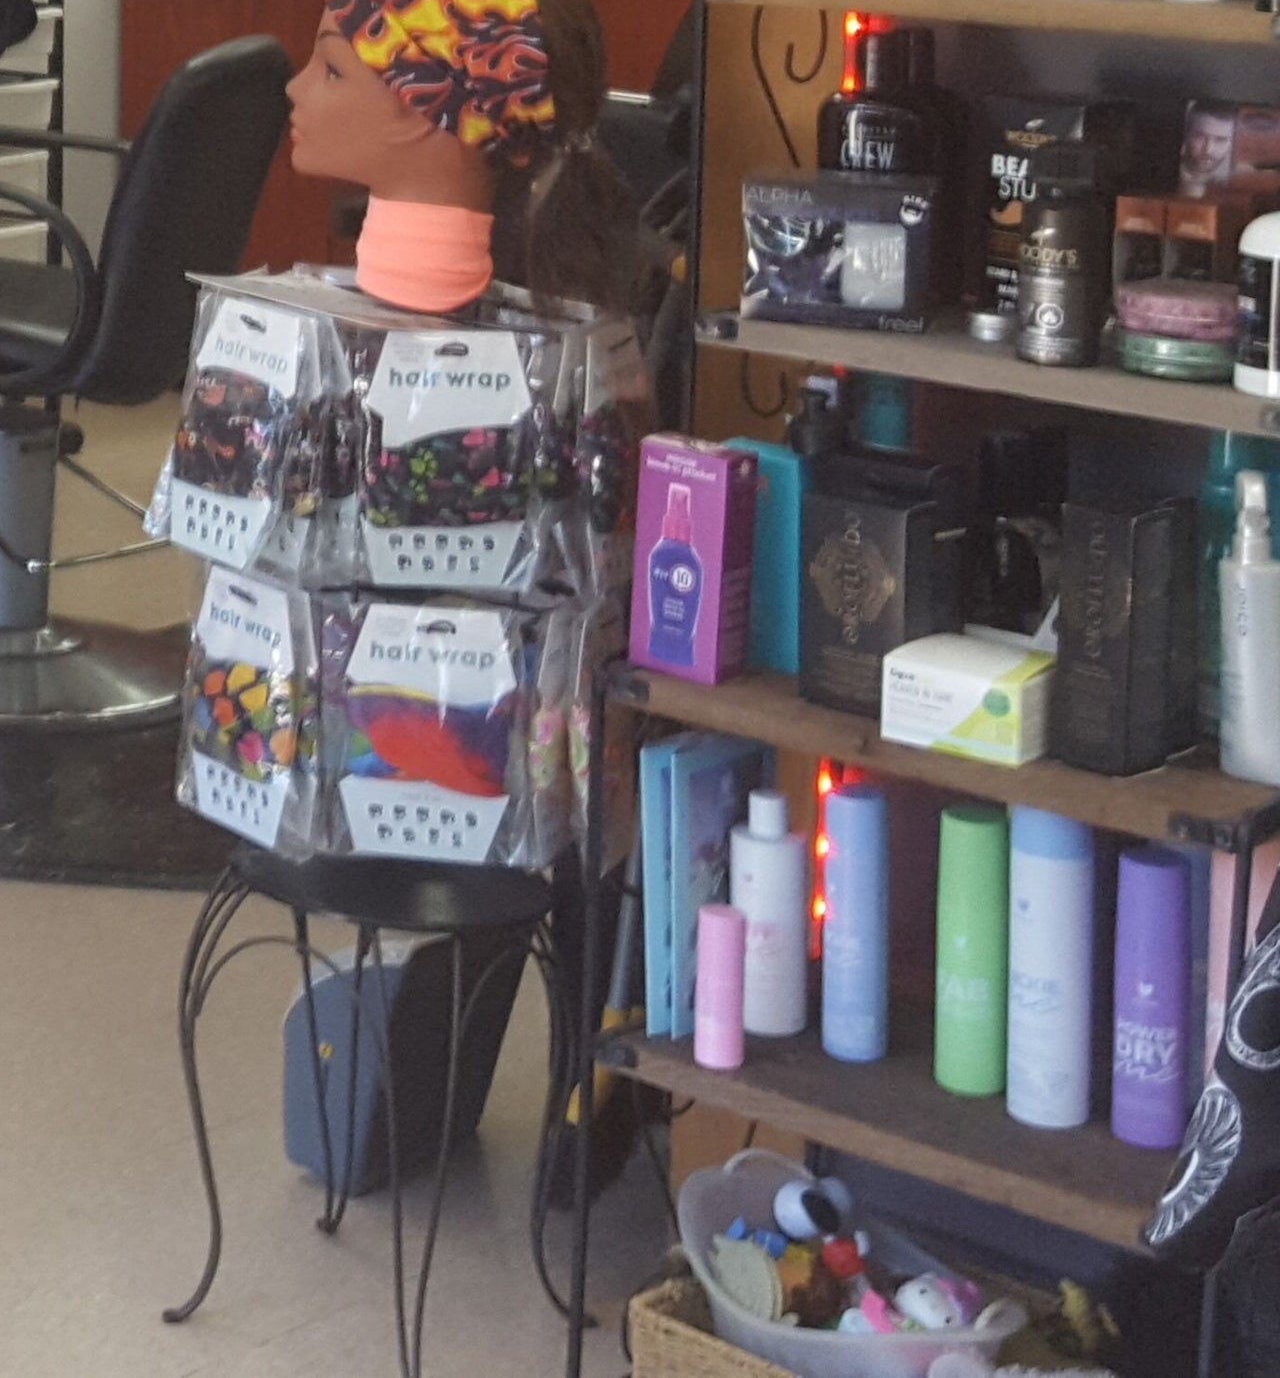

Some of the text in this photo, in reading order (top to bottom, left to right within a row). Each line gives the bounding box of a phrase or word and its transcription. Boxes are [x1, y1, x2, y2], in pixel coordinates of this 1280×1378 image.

[841, 140, 895, 171] CREW
[745, 186, 814, 206] ALPHA
[214, 333, 289, 374] hair wrap
[389, 368, 511, 392] hair wrap
[209, 601, 283, 648] hair wrap
[369, 640, 498, 670] hair wrap
[1116, 1034, 1178, 1066] DRY
